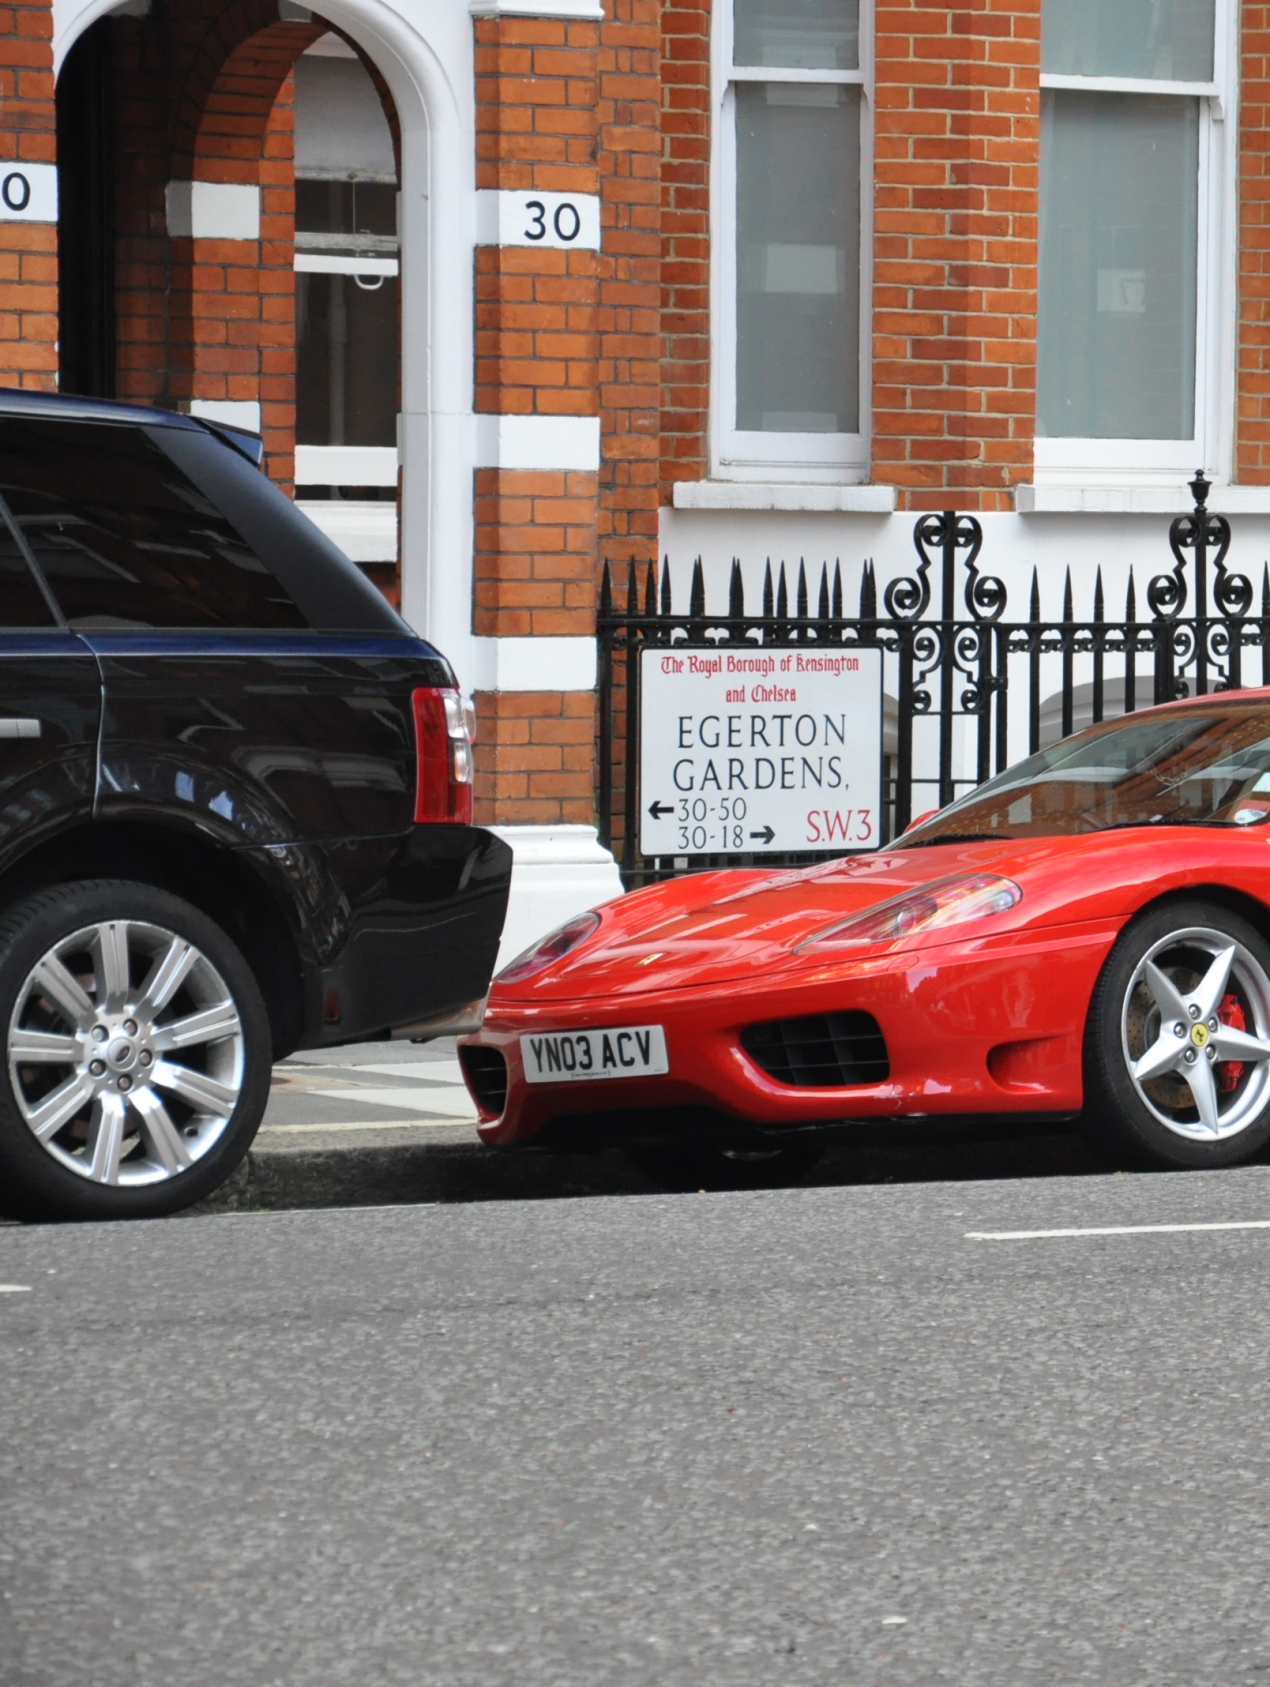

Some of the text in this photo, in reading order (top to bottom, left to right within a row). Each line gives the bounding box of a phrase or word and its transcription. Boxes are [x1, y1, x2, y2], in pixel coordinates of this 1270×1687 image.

[523, 200, 581, 242] 30
[661, 653, 859, 678] The Royal Borough of Kensington
[725, 684, 797, 703] and Chelsea
[677, 713, 846, 749] EGERTON
[673, 756, 850, 792] GARDENS,
[530, 1030, 650, 1073] YN03 ACV
